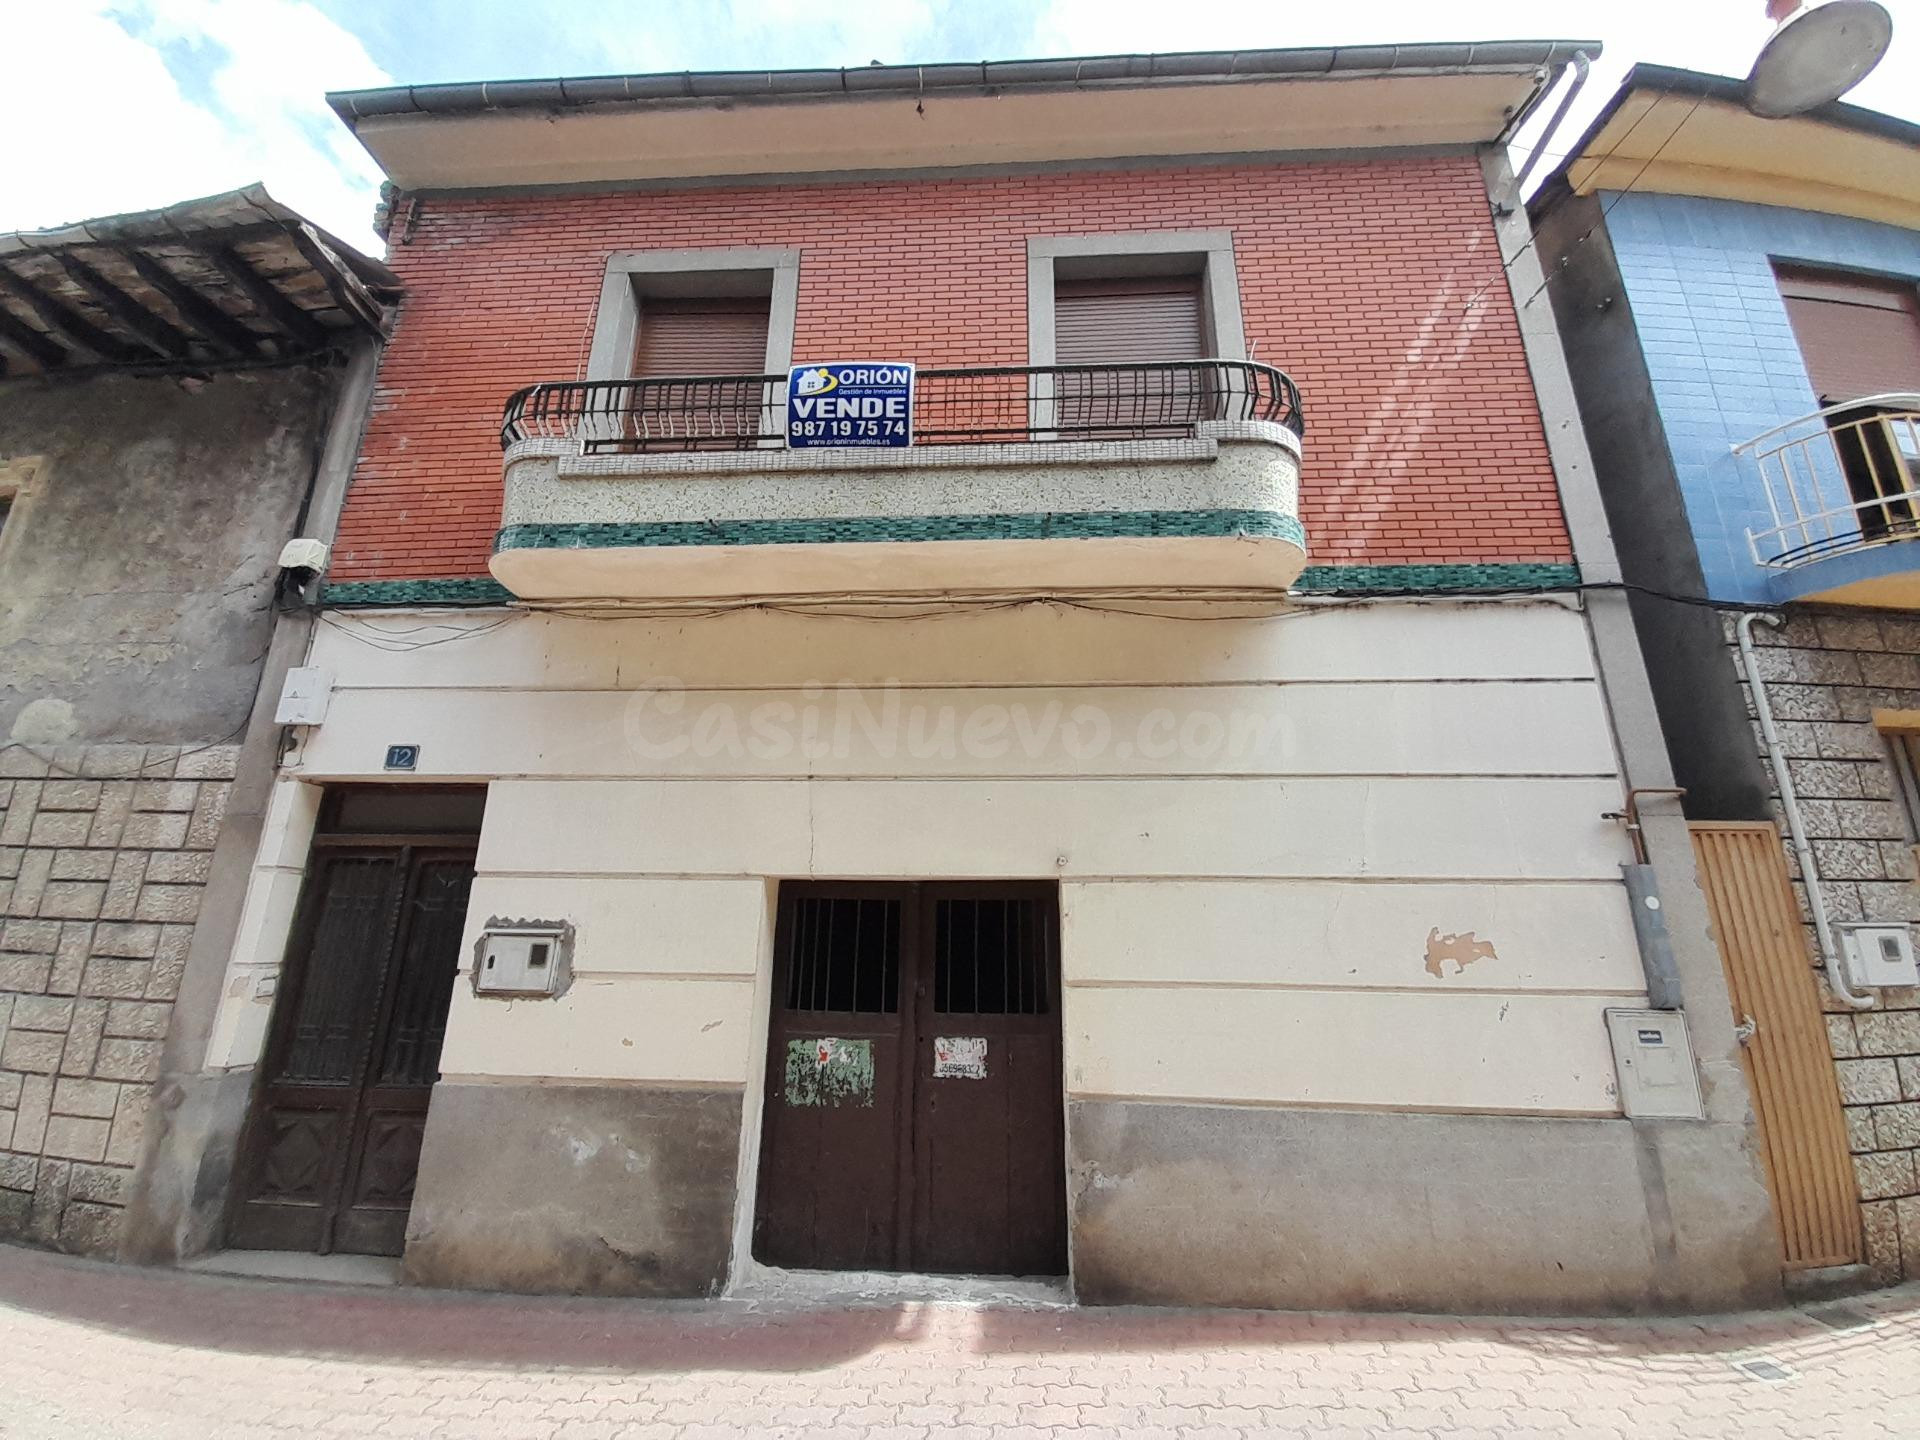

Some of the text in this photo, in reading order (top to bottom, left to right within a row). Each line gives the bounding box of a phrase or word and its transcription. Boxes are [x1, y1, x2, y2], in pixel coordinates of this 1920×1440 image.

[838, 367, 908, 384] ORIÓN
[838, 388, 863, 396] Gestión
[864, 388, 873, 396] de
[792, 398, 907, 418] VENDE
[791, 420, 906, 437] 987 19 75 74
[392, 748, 411, 765] 12
